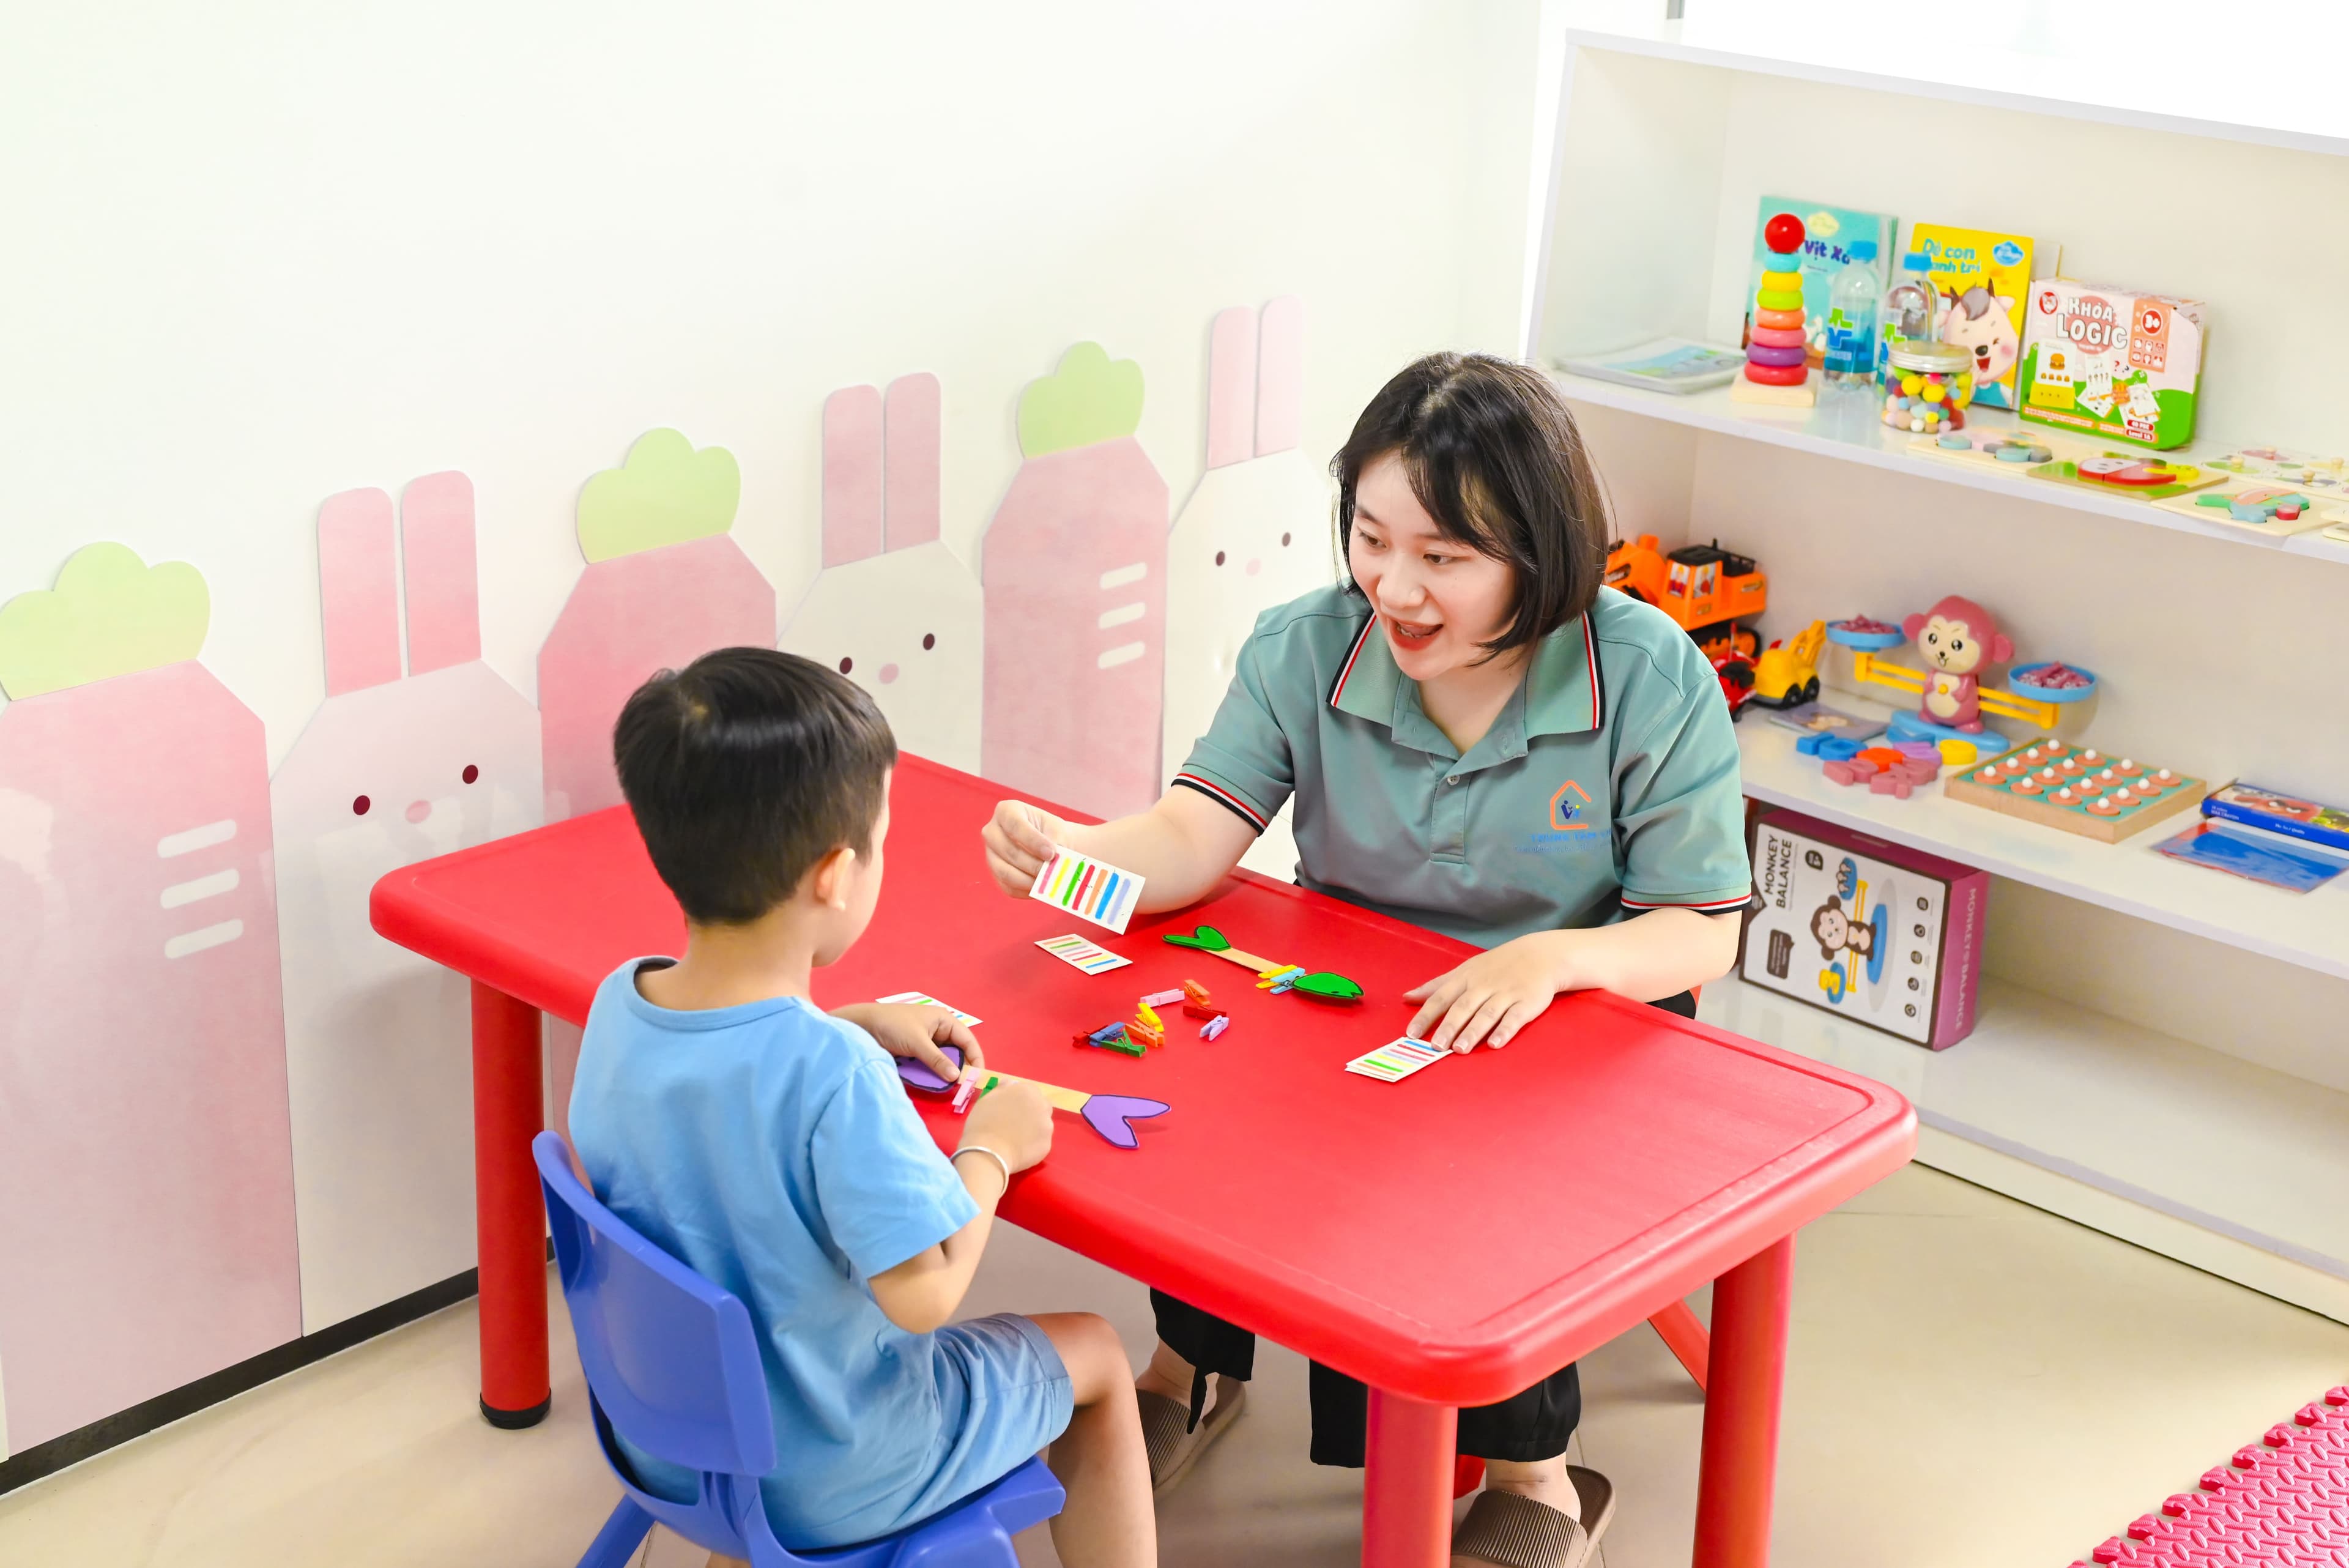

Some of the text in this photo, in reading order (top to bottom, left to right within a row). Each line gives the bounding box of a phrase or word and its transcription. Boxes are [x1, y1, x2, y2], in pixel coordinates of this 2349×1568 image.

[1945, 247, 1976, 260] con
[2056, 313, 2128, 350] LOGIC
[2144, 313, 2161, 329] 3+
[1764, 834, 1778, 895] MONKEY
[1775, 839, 1792, 909] BALANCE
[1954, 963, 1969, 1031] BALANCE
